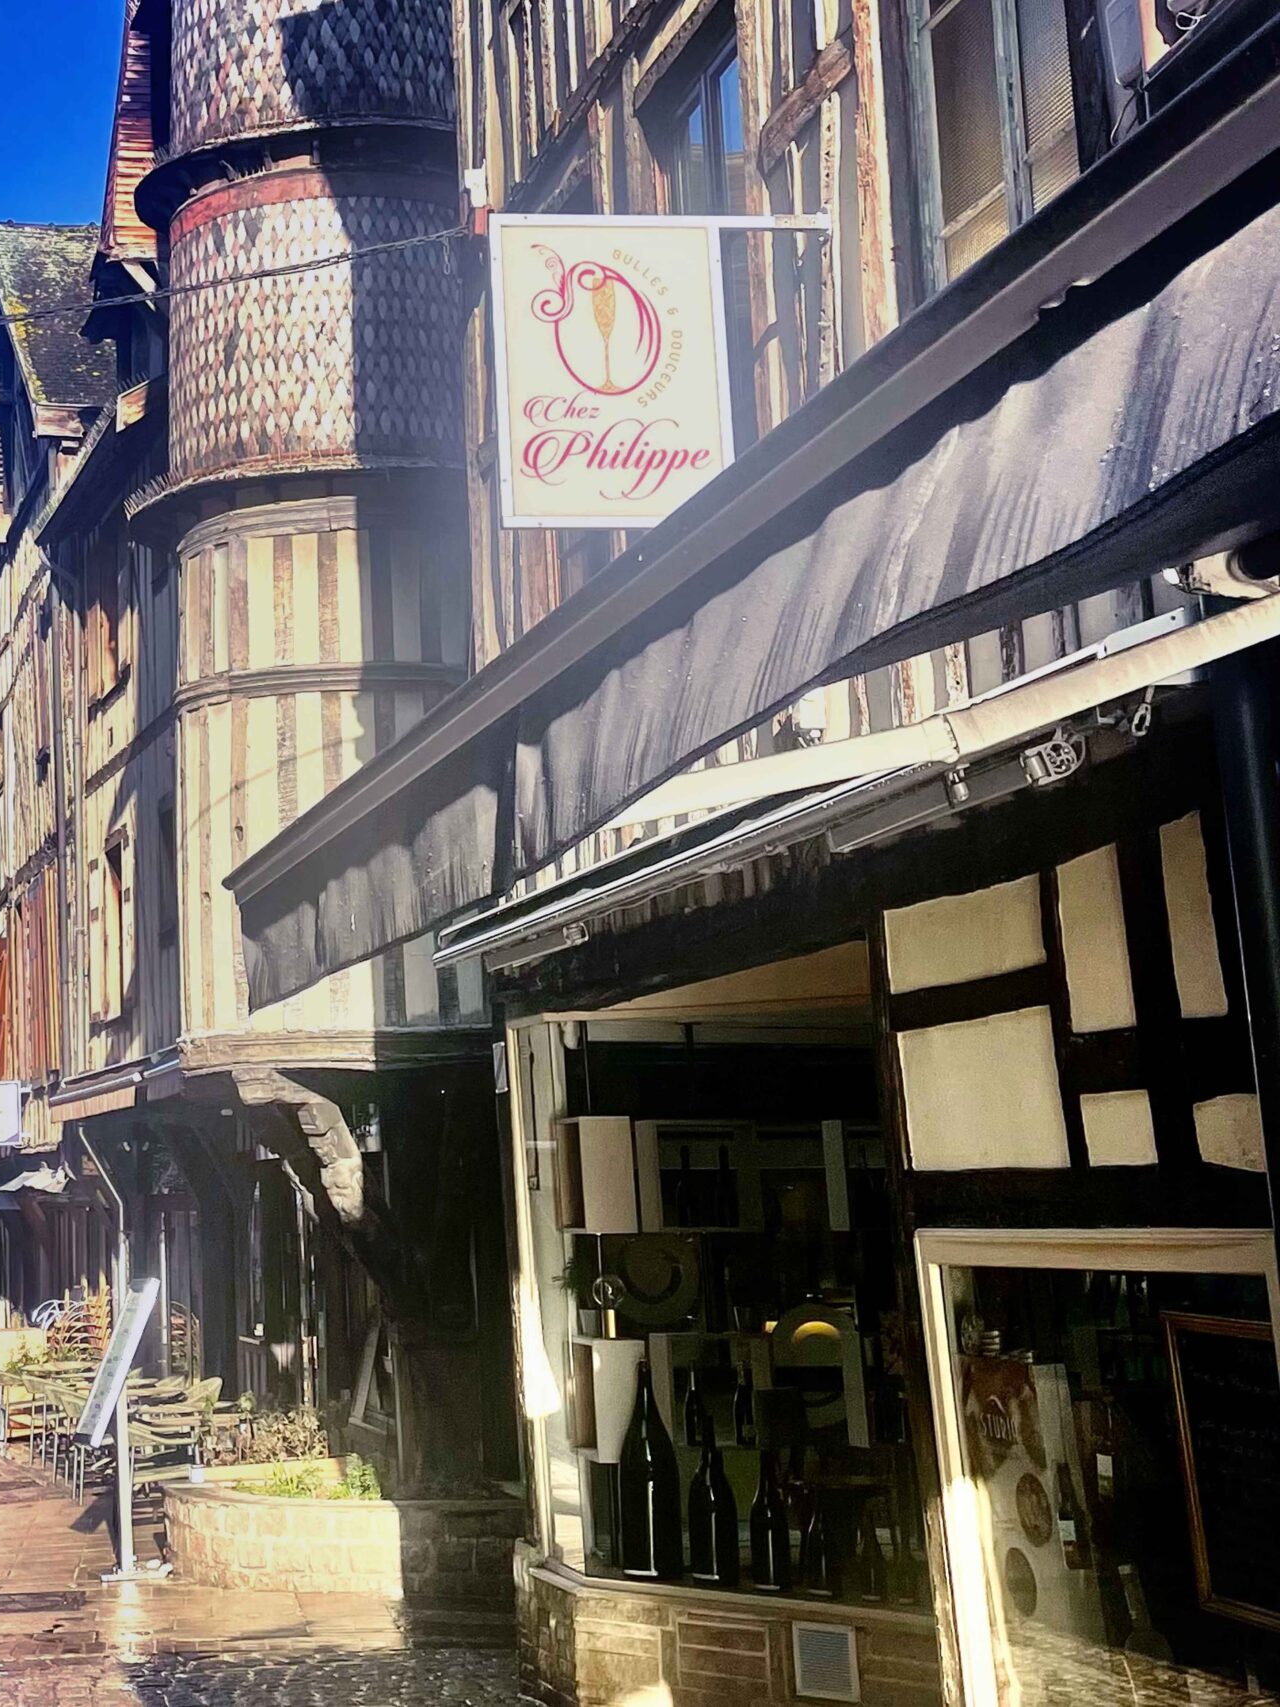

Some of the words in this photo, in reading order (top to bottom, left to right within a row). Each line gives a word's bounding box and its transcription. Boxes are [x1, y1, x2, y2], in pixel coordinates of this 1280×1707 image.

[612, 248, 669, 297] BULLES
[666, 307, 679, 316] &
[637, 329, 683, 408] DOUCEURS
[523, 391, 600, 428] Chez
[520, 418, 713, 500] Philippe
